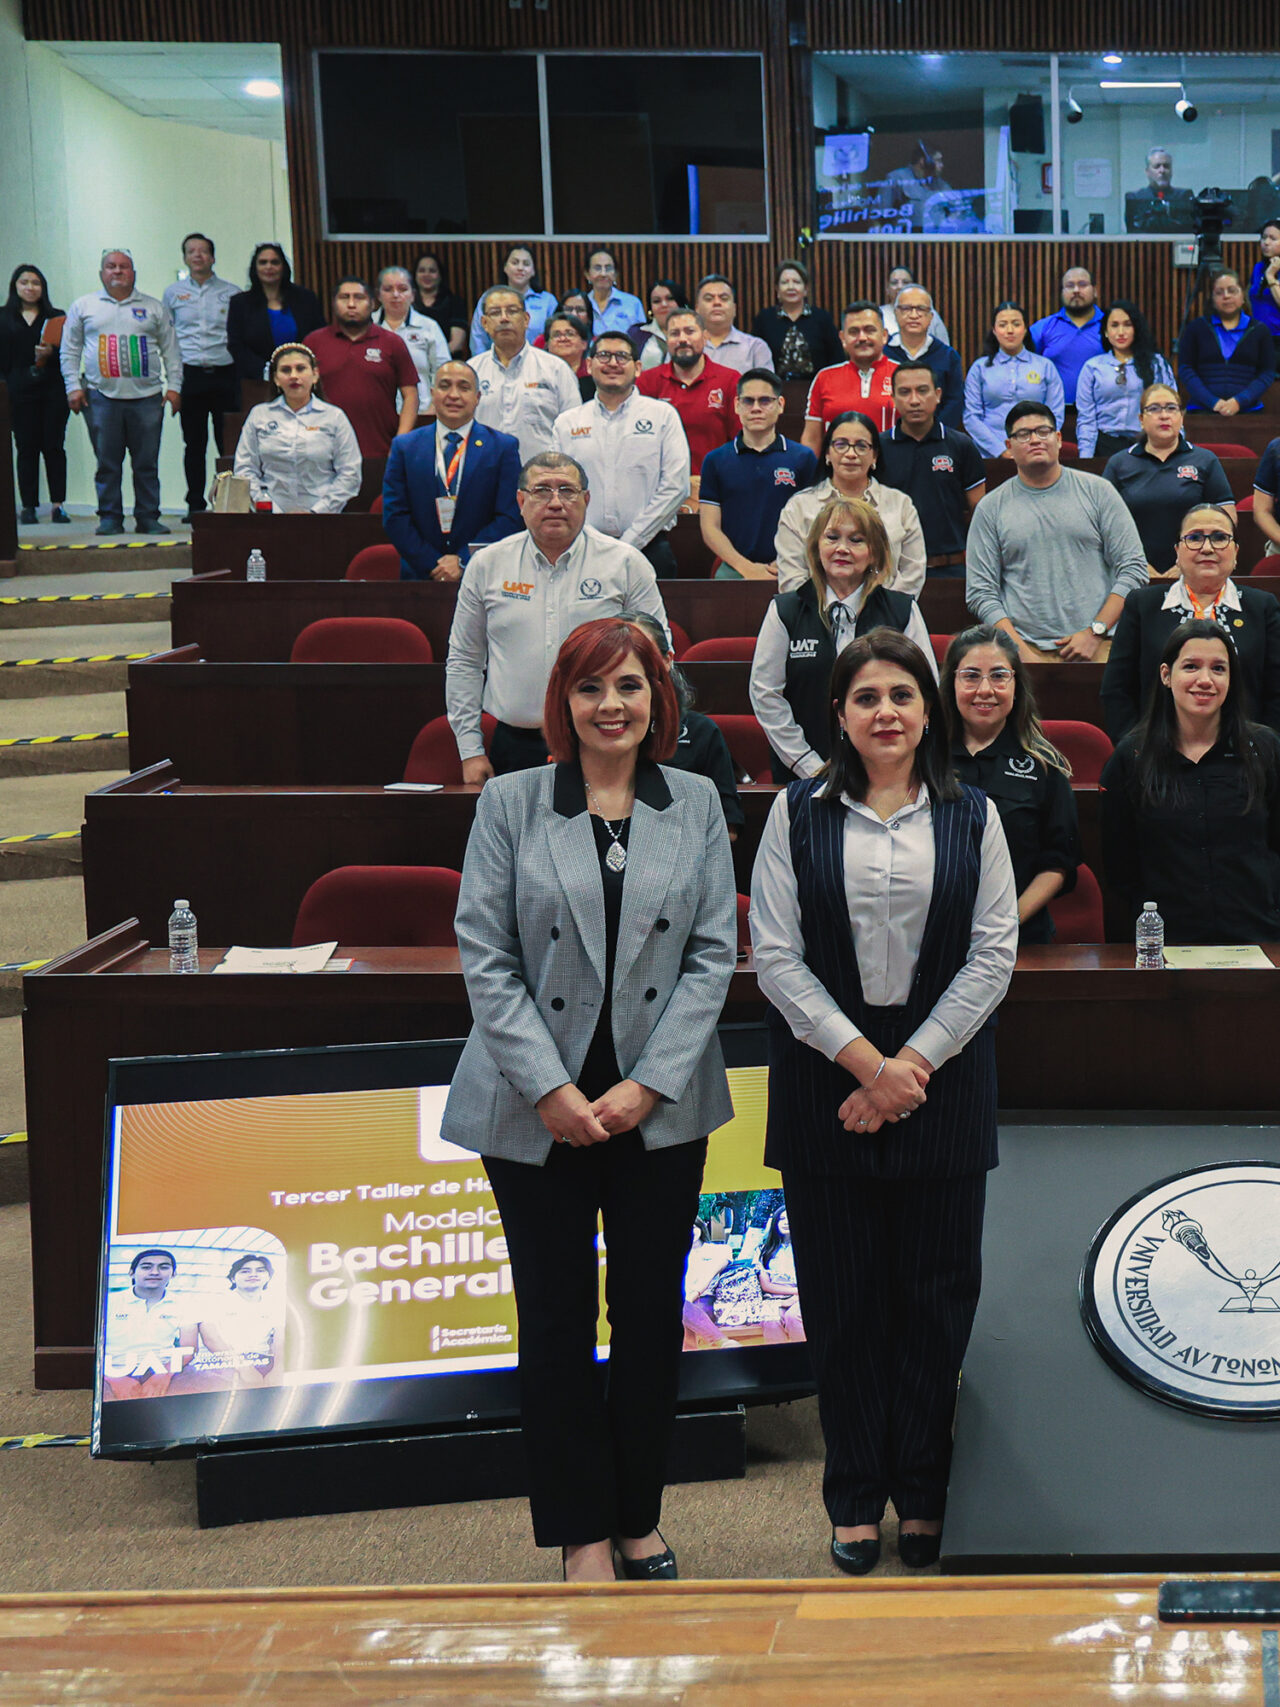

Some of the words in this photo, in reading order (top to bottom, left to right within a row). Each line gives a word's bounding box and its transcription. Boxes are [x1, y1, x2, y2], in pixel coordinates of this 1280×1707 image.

[503, 580, 534, 595] UAT
[790, 638, 819, 652] UAT
[270, 1189, 351, 1206] Tercer
[357, 1182, 424, 1201] Taller
[430, 1180, 461, 1195] de
[308, 1264, 513, 1308] General
[440, 1333, 513, 1347] Académica
